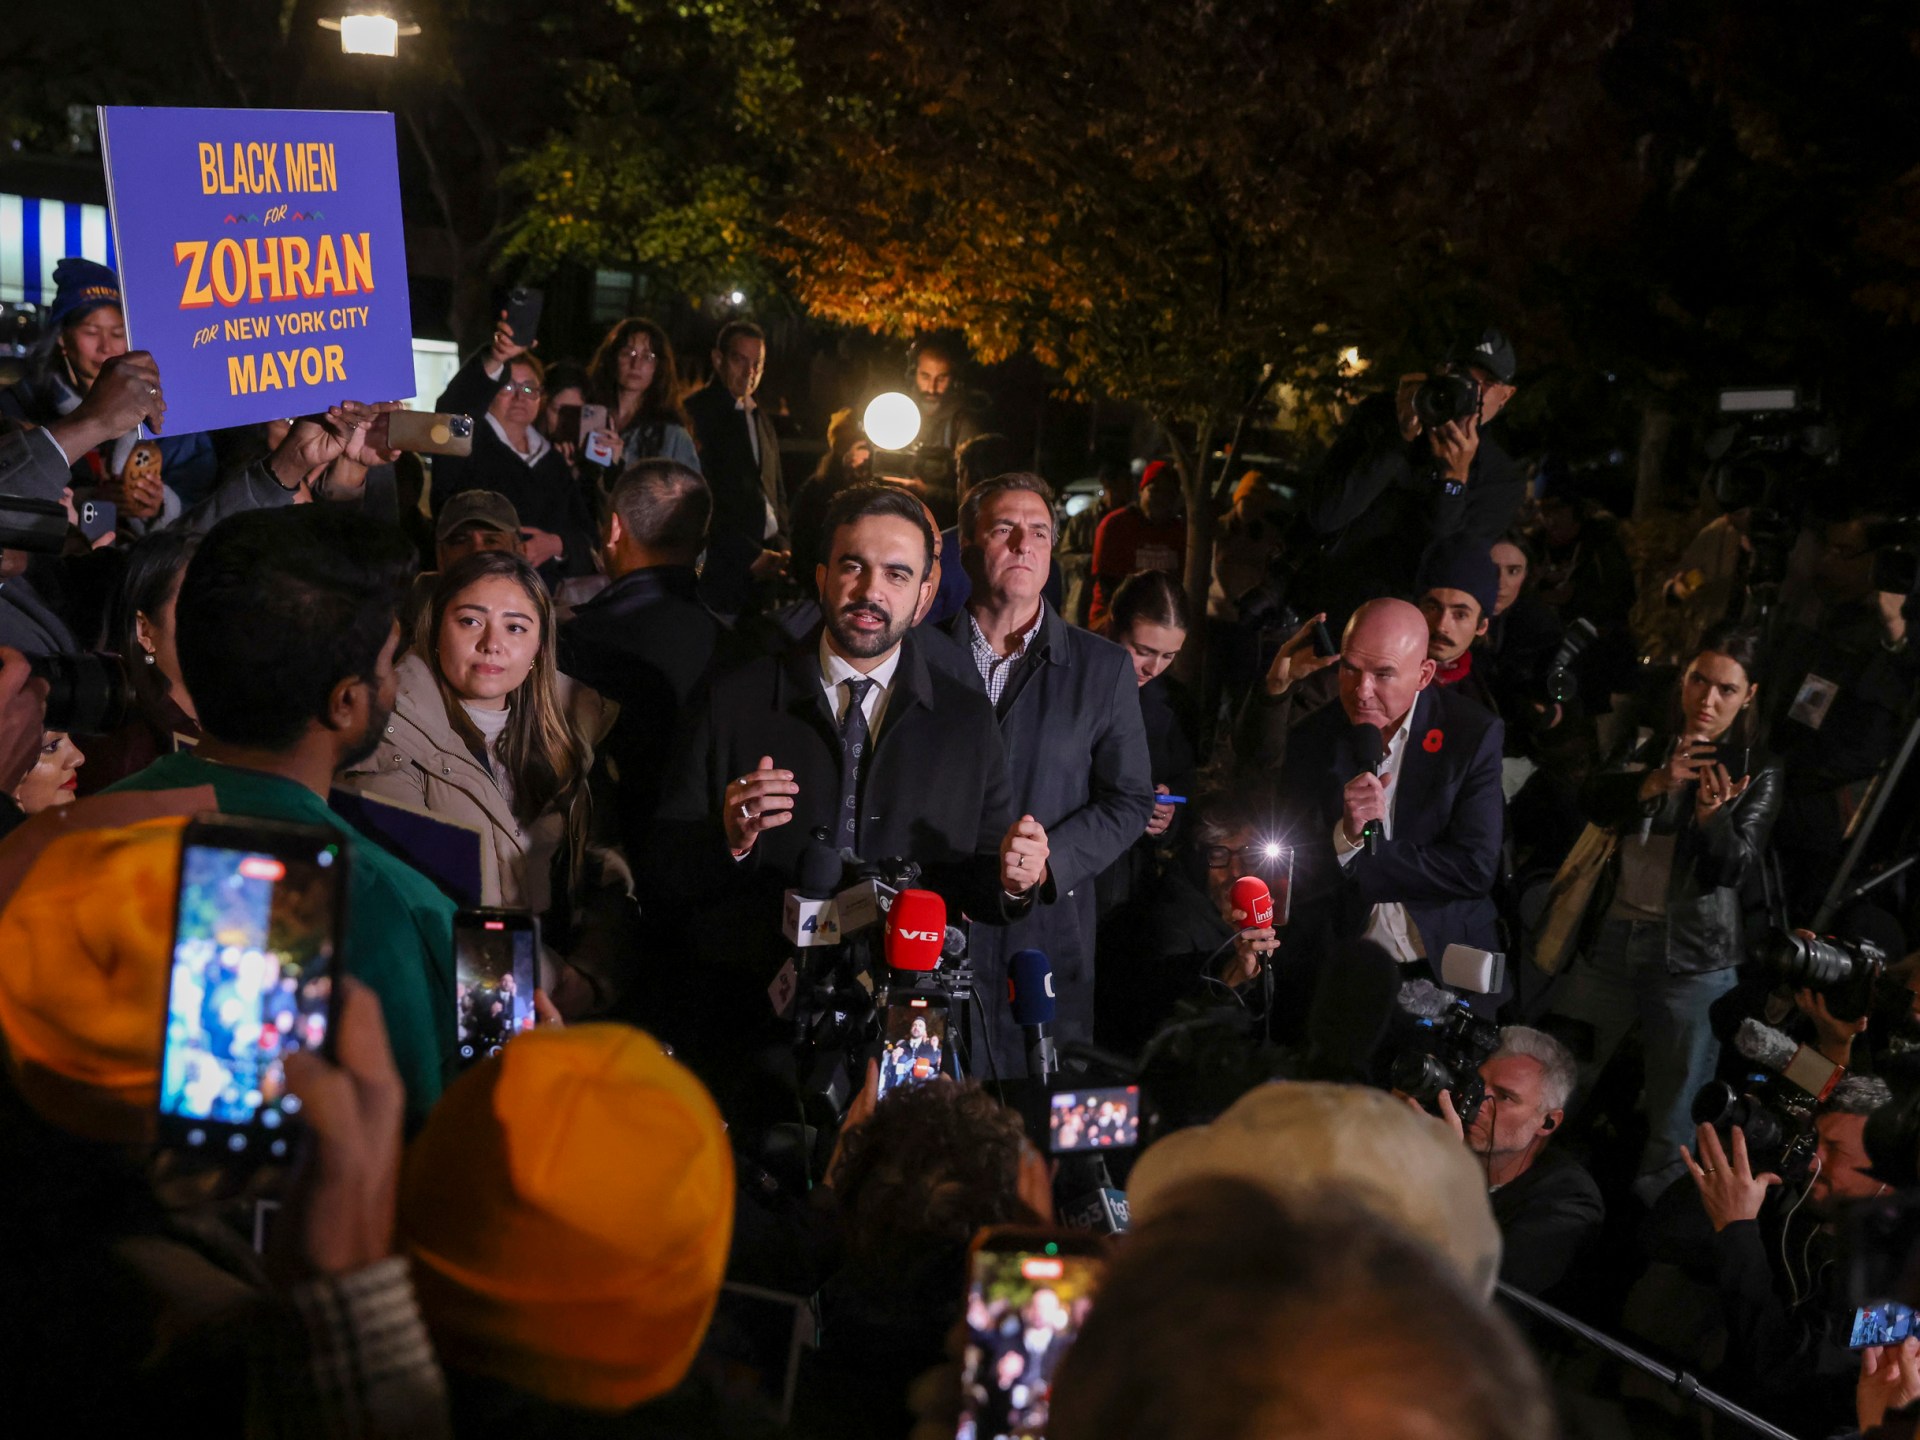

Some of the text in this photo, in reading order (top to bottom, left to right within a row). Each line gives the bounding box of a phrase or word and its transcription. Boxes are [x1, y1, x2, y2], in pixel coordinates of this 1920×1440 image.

[199, 142, 338, 195] BLACK MEN
[263, 204, 288, 227] FOR
[174, 232, 375, 310] ZOHRAN
[192, 306, 369, 349] FOR NEW YORK CITY
[227, 344, 347, 396] MAYOR
[801, 914, 818, 934] 4
[898, 928, 939, 942] VG
